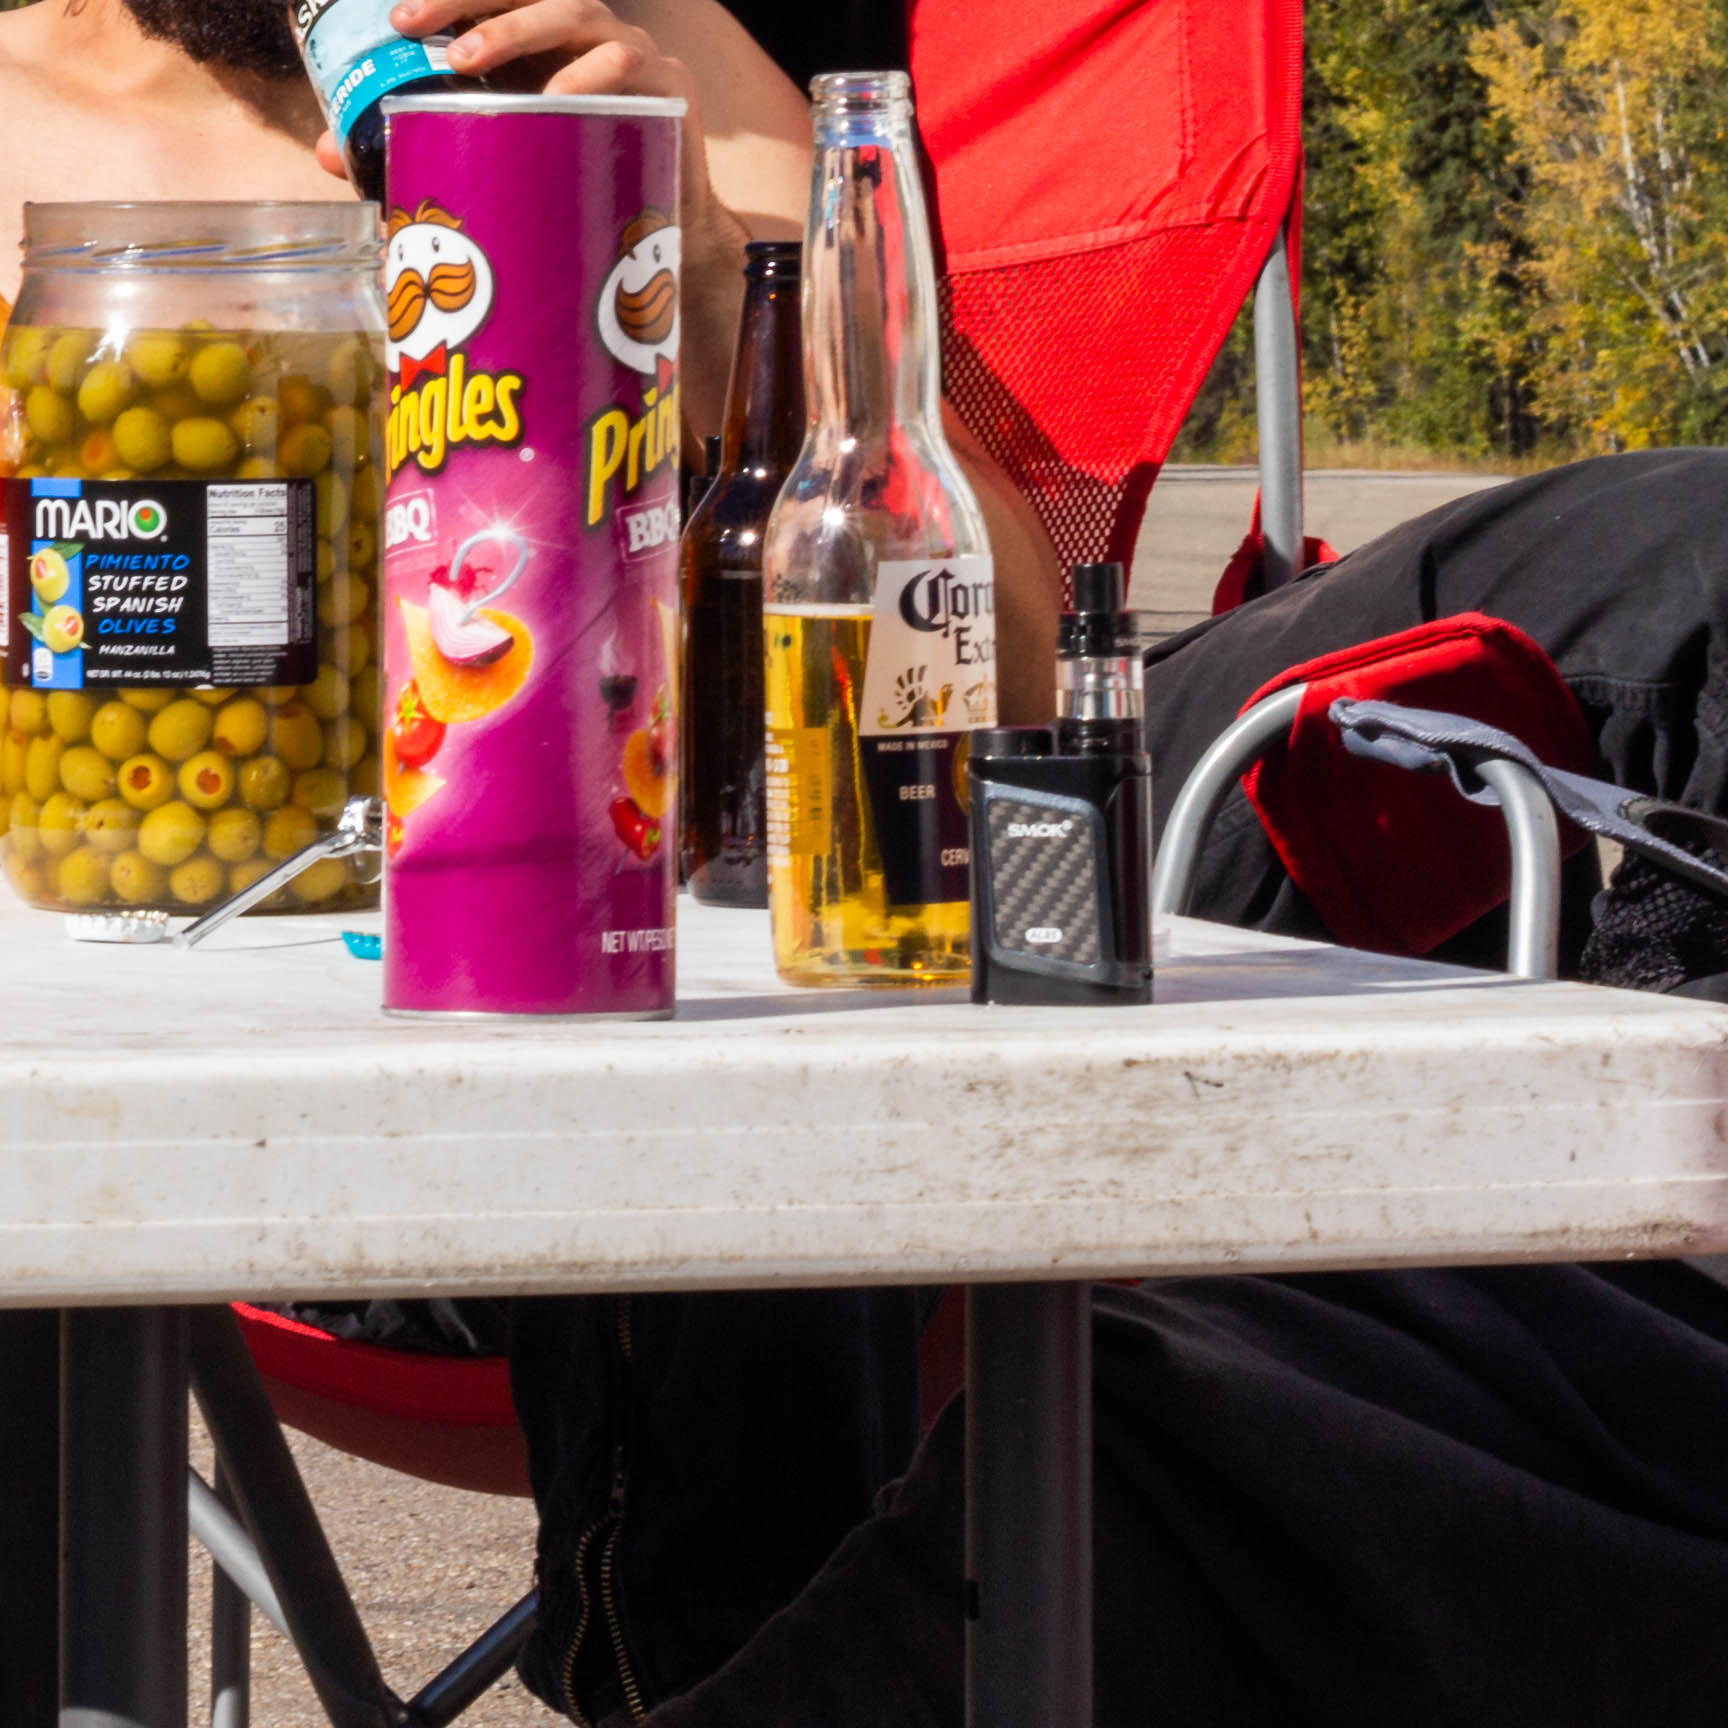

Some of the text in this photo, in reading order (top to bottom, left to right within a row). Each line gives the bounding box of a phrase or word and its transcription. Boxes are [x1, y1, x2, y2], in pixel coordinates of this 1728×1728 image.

[35, 498, 168, 540] MARIO
[85, 554, 191, 571] PIMIENTO
[87, 574, 189, 592] STUFFED
[92, 596, 184, 613] SPANISH
[97, 617, 177, 635] OLIVES
[98, 644, 176, 656] MANZANILLA
[898, 783, 936, 801] BEER
